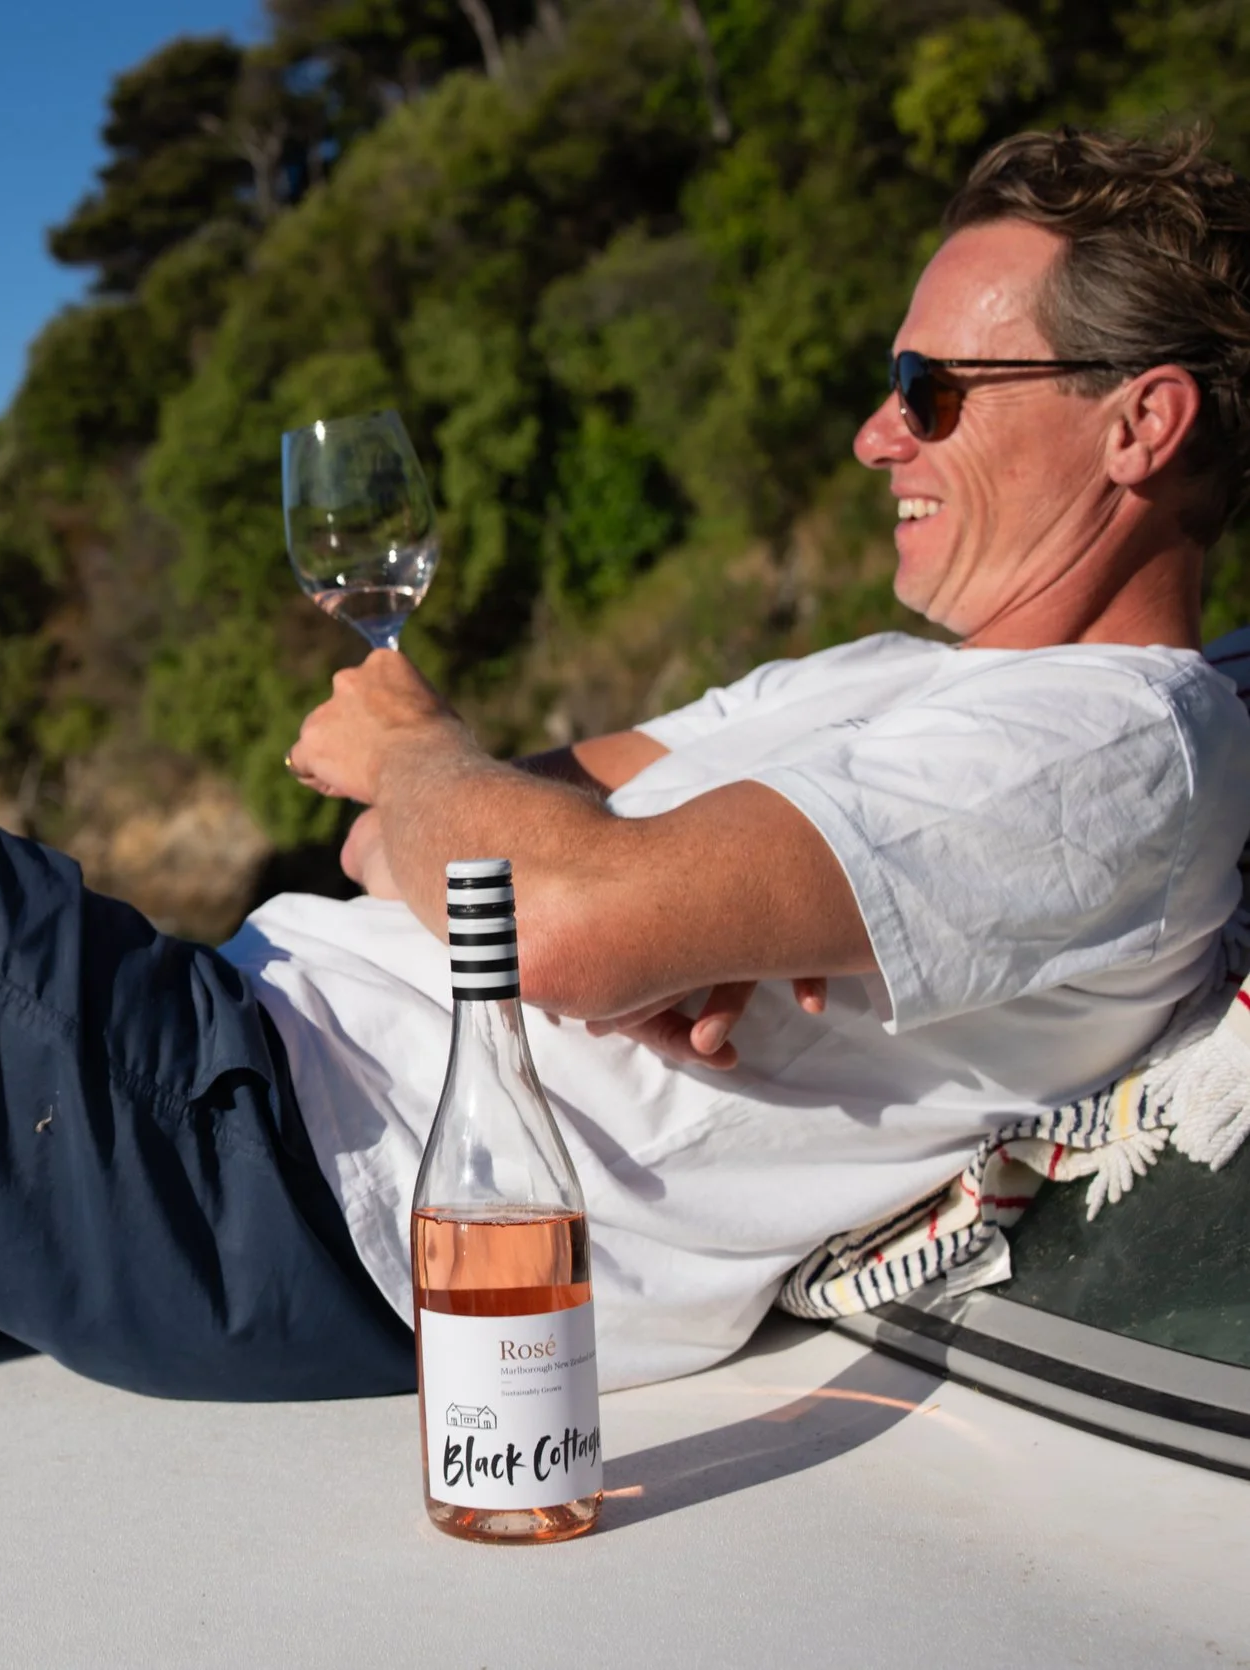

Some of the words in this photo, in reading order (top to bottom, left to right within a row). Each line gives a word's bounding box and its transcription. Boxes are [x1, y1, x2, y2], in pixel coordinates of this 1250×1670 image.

[499, 1333, 557, 1361] Rosé
[500, 1363, 553, 1376] Marlborough
[554, 1361, 569, 1370] New
[501, 1388, 540, 1397] Sustainably
[541, 1385, 562, 1394] Grown
[443, 1435, 527, 1488] Black
